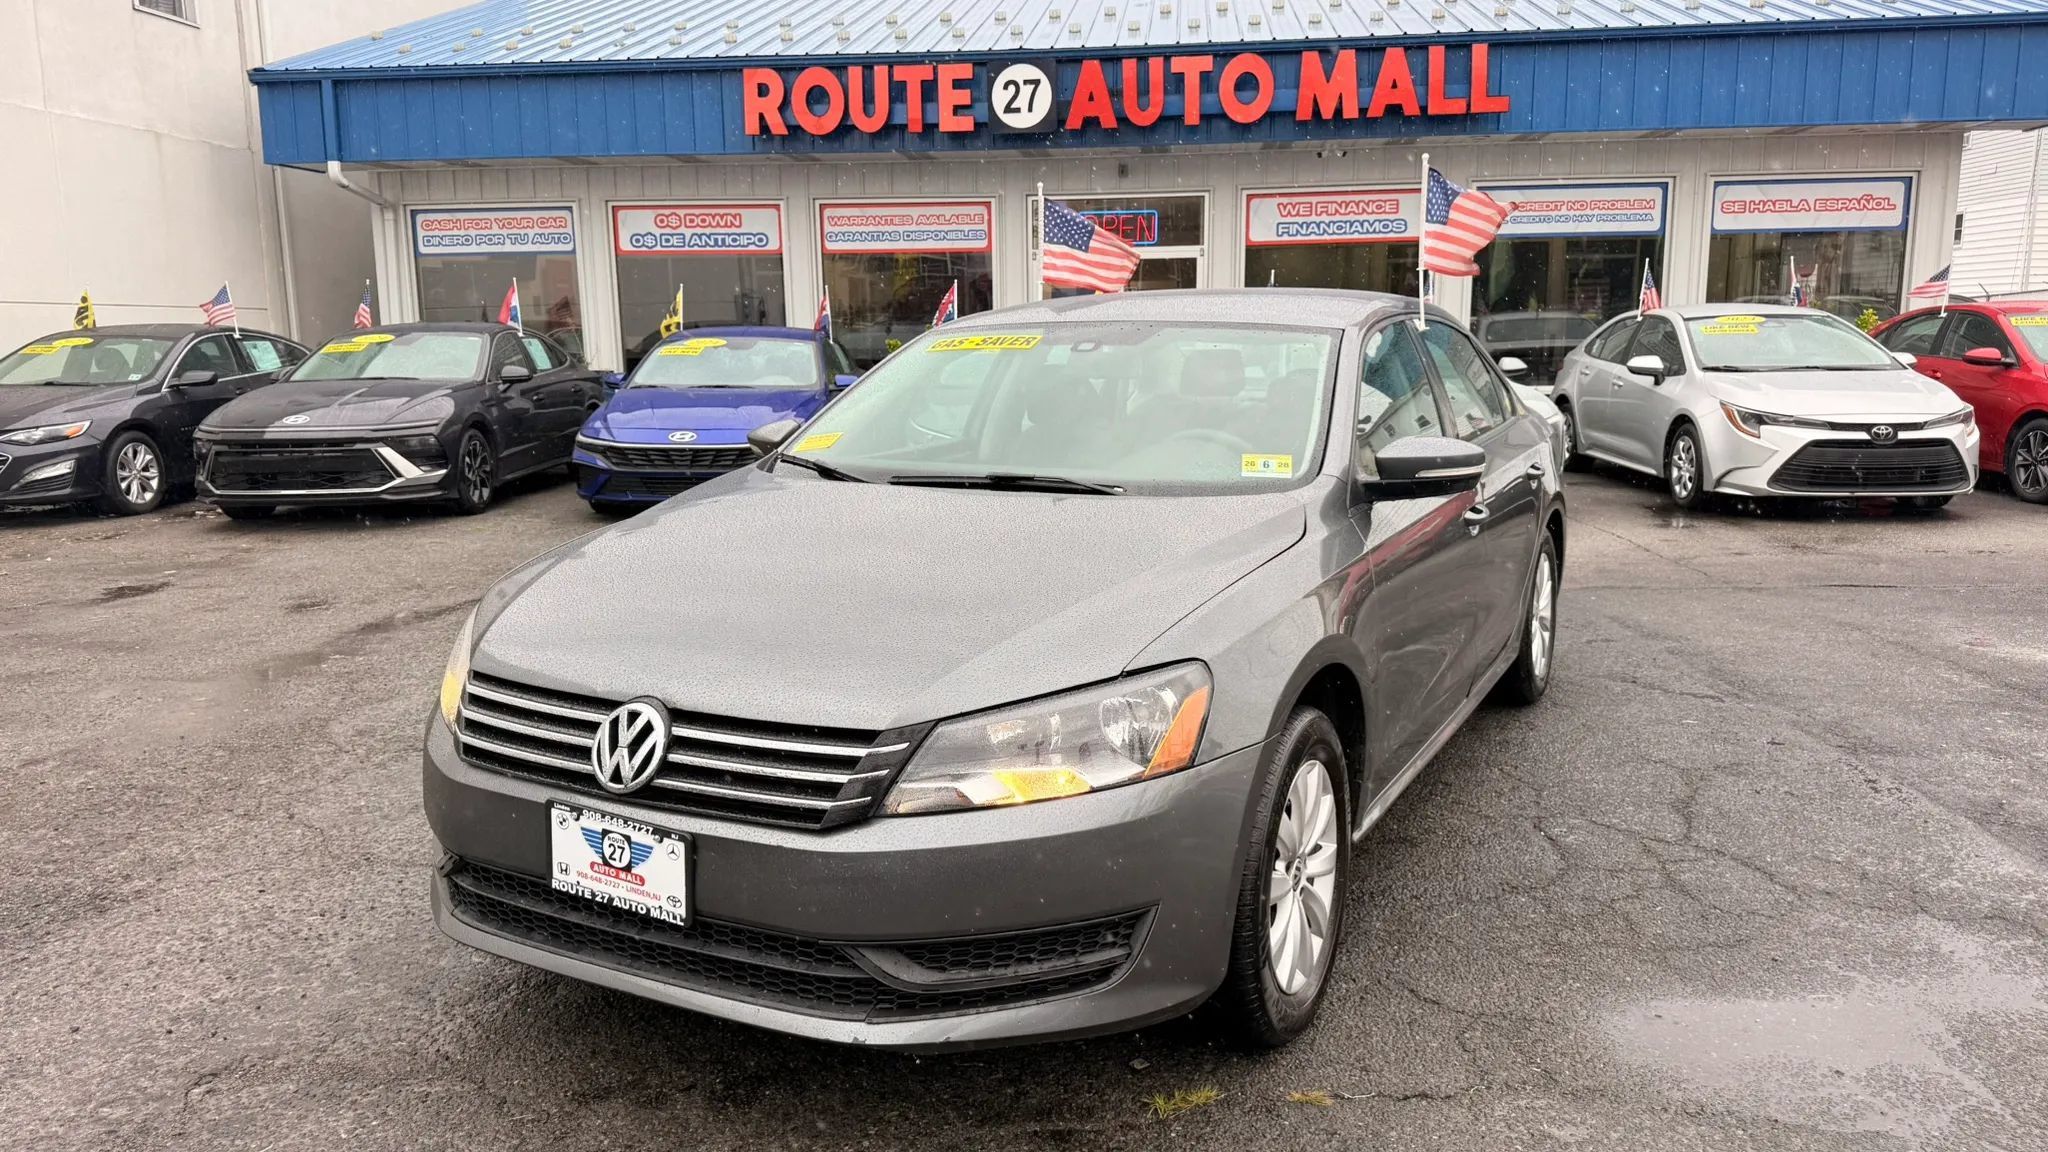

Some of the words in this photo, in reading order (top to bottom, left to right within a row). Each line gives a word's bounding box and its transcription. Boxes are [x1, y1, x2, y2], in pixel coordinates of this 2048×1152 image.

[742, 63, 975, 136] ROUTE
[1002, 78, 1041, 114] 27
[1064, 53, 1275, 130] AUTO
[1295, 43, 1510, 121] MALL
[1277, 202, 1312, 217] WE
[1315, 199, 1399, 217] FINANCE
[1517, 201, 1564, 212] CREDIT
[1566, 200, 1588, 212] NO
[1590, 199, 1655, 211] PROBLEM
[1721, 200, 1746, 213] SE
[1749, 199, 1810, 213] HABLA
[1814, 194, 1896, 212] ESPAÑOL
[421, 219, 461, 231] CASH
[463, 218, 491, 231] FOR
[494, 217, 534, 229] YOUR
[537, 216, 568, 229] CAR
[684, 213, 741, 229] DOWN
[828, 215, 913, 227] WARRANTIES
[915, 214, 984, 225] AVAILABLE
[1510, 214, 1553, 224] CREDITO
[1554, 214, 1570, 223] NO
[1572, 213, 1594, 223] HAY
[1596, 212, 1653, 222] PROBLEMA
[826, 231, 900, 242] GARANTIAS
[902, 230, 986, 242] DISPONIBLES
[1276, 219, 1407, 237] FINANCIAMOS
[423, 234, 473, 247] DINERO
[475, 234, 504, 245] POR
[507, 233, 528, 245] TU
[531, 232, 572, 244] AUTO
[659, 233, 686, 249] DE
[688, 233, 768, 248] ANTICIPO
[1263, 460, 1270, 468] 6
[582, 809, 654, 834] 908-648-2727
[607, 836, 626, 845] ROUTE
[608, 843, 625, 863] 27
[593, 863, 616, 877] AUTO
[619, 870, 642, 884] MALL
[552, 878, 592, 899] ROUTE
[595, 891, 610, 904] 27
[612, 896, 647, 914] AUTO
[650, 906, 684, 926] MALL
